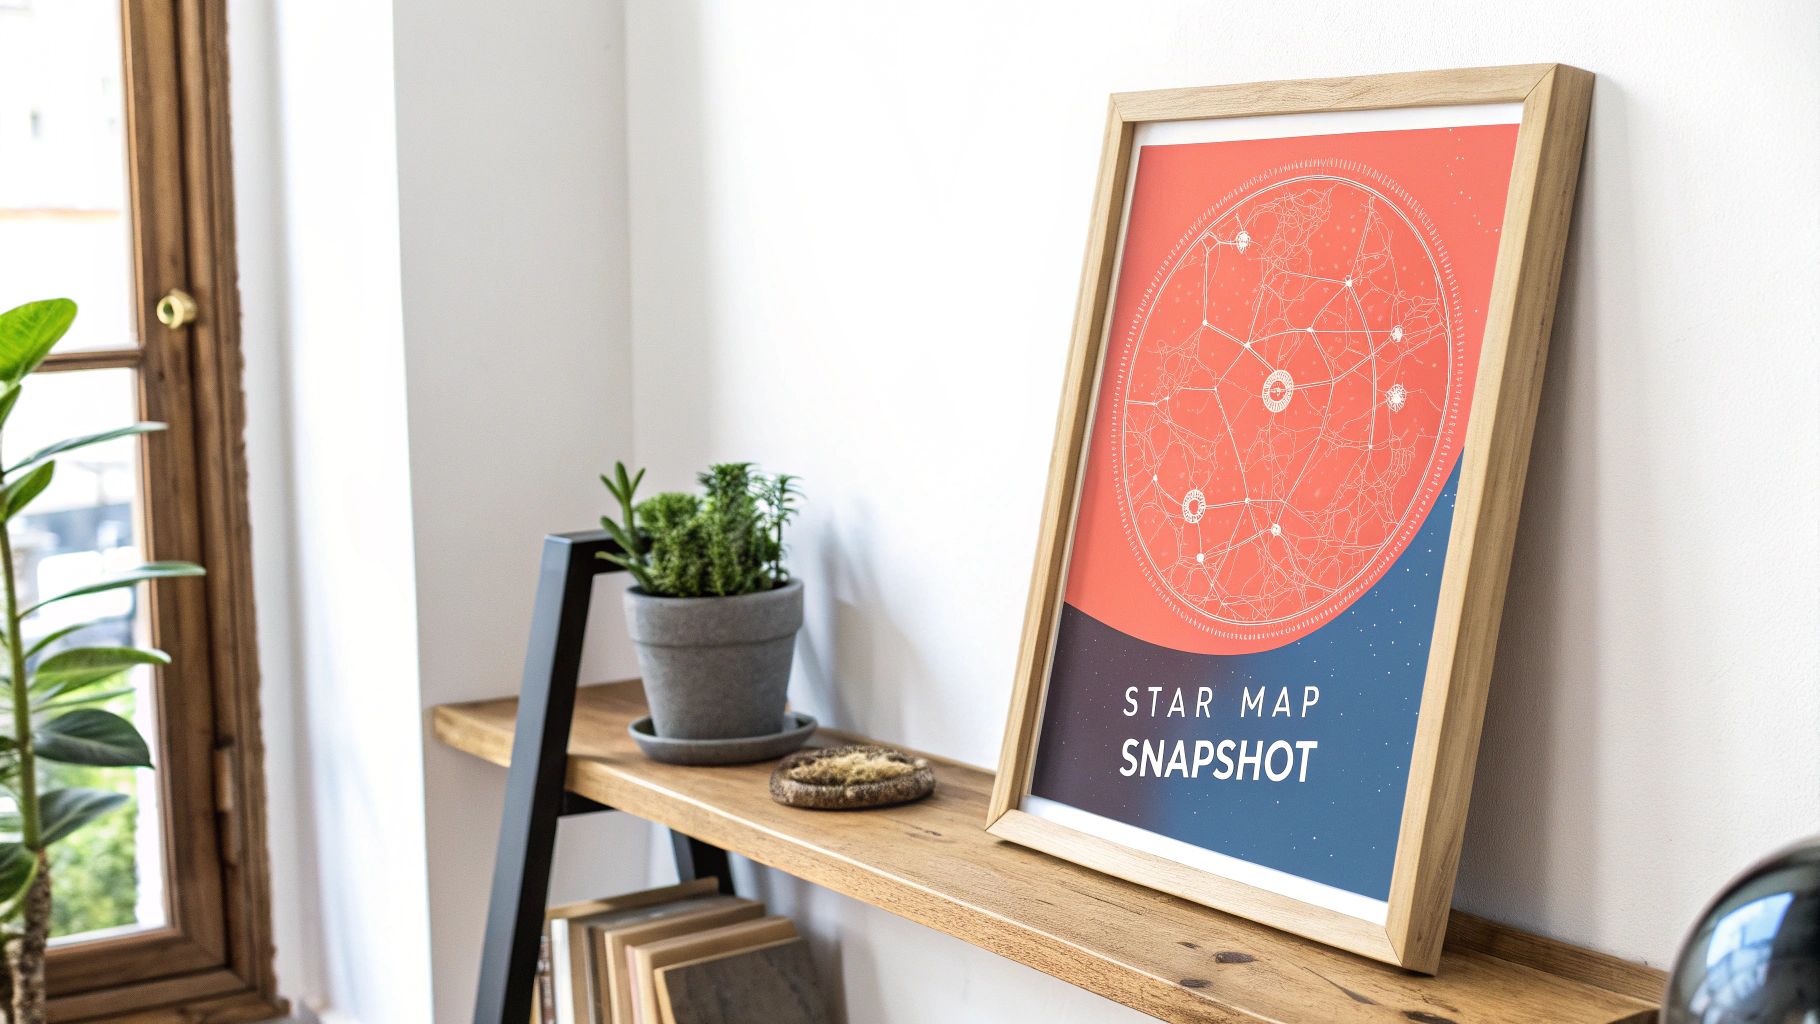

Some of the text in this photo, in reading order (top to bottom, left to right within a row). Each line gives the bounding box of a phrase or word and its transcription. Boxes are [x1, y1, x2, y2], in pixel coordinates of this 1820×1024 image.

[1122, 686, 1320, 718] STAR MAP
[1119, 738, 1318, 782] SNAPSHOT
